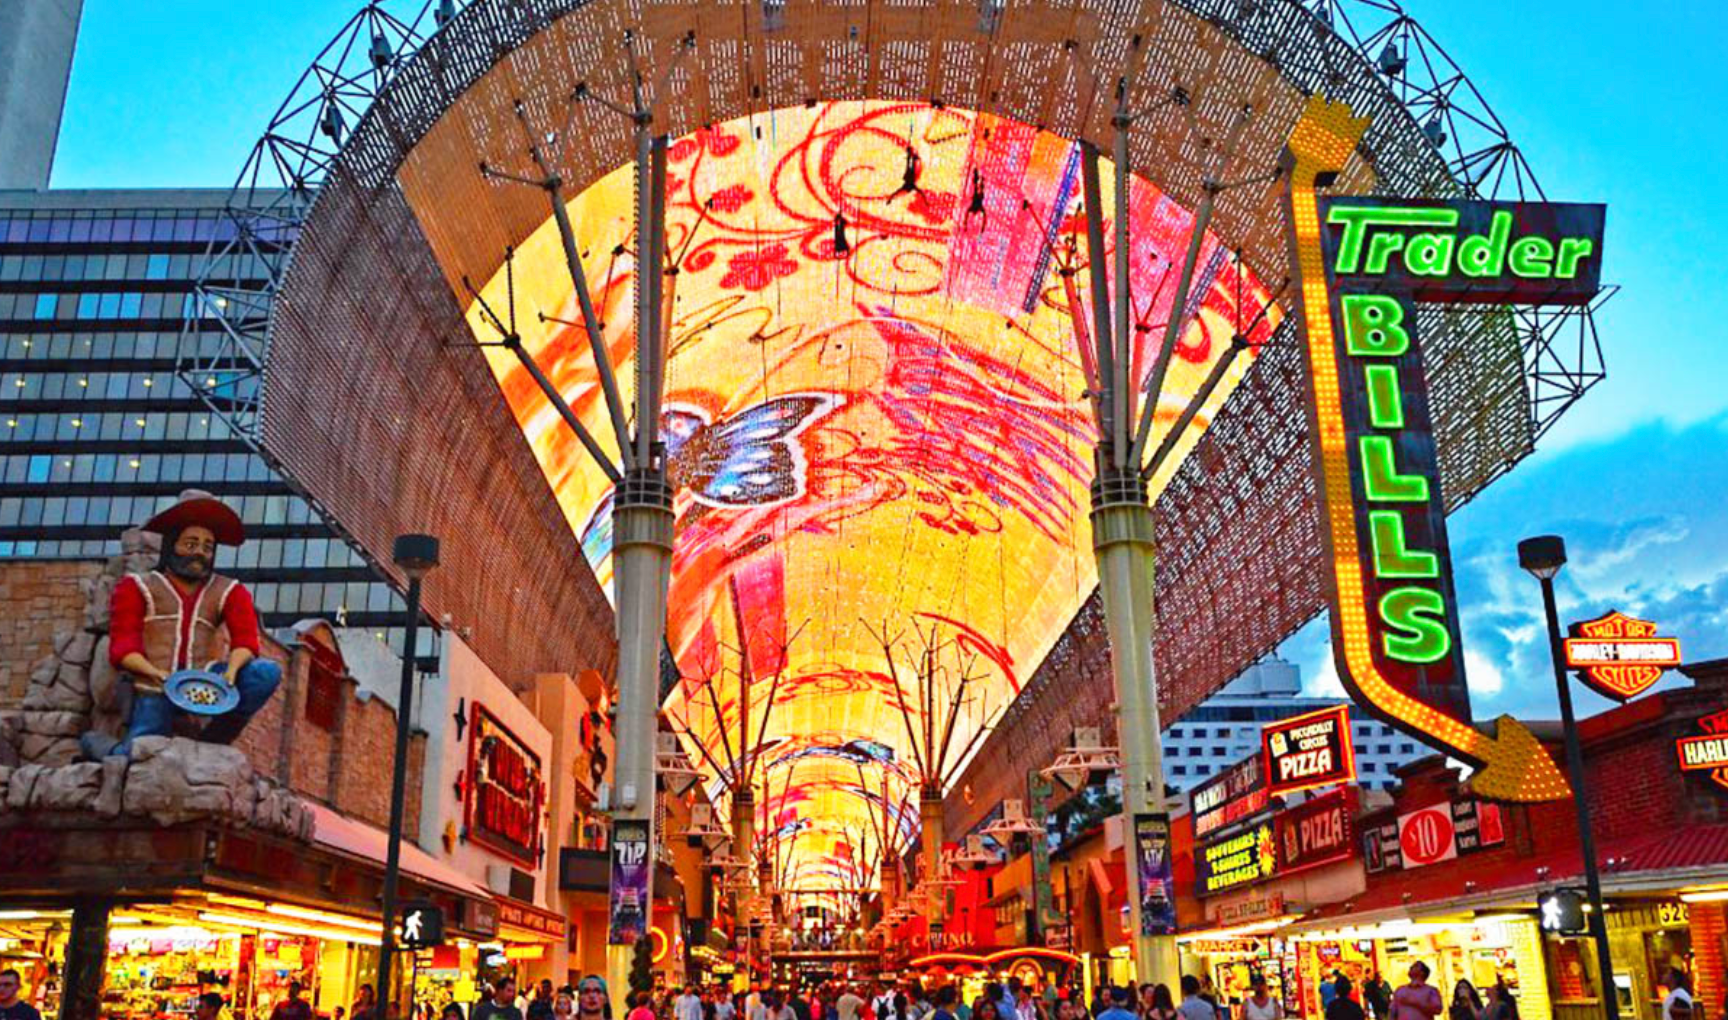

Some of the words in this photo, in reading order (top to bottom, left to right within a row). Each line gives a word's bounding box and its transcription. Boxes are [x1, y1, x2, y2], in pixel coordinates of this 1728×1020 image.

[1327, 206, 1593, 279] Trader
[1341, 294, 1451, 664] BILLS
[1593, 618, 1646, 637] MOTOR
[1601, 666, 1653, 688] CYCLES
[1280, 748, 1332, 779] PIZZA
[1301, 808, 1343, 853] PIZZA
[1196, 939, 1254, 952] MARKET
